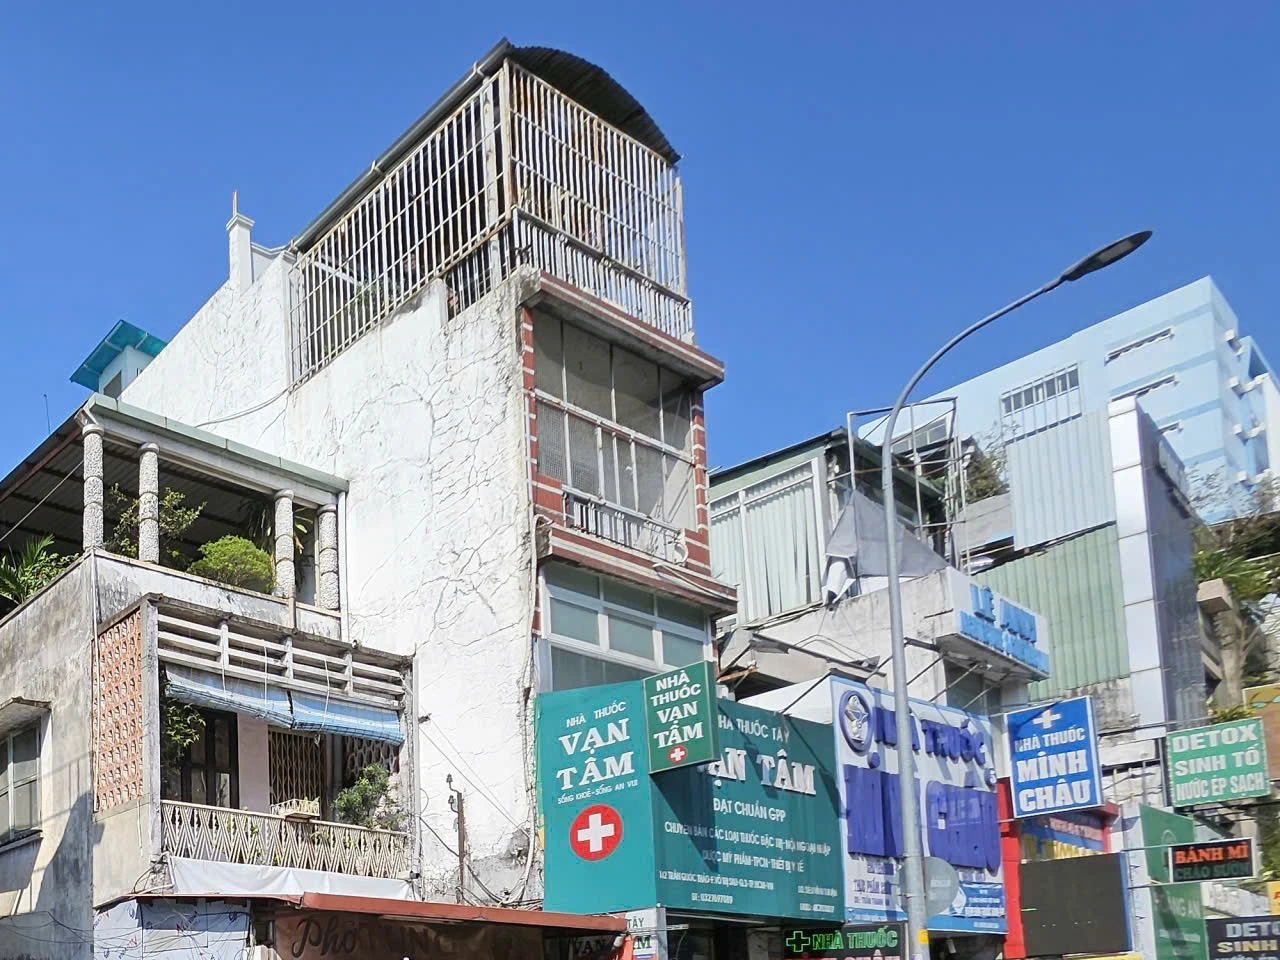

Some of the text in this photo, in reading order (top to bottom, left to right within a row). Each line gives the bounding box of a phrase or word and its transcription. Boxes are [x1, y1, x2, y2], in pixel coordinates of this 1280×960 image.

[655, 670, 690, 692] NHÀ
[650, 683, 702, 707] THUỐC
[566, 699, 627, 728] NHÀ THUỐC
[656, 700, 699, 724] VẠN
[558, 717, 631, 756] VẠN
[653, 722, 704, 749] TÂM
[735, 718, 769, 739] THUỐC
[1042, 724, 1086, 747] THUỐC
[1172, 723, 1259, 753] DETOX
[556, 751, 636, 791] TÂM
[697, 747, 817, 796] ẠN TÂM
[1175, 743, 1260, 777] SINH TỐ
[557, 793, 575, 805] SỐNG
[615, 782, 625, 791] AN
[627, 779, 638, 788] VUI
[1018, 778, 1091, 812] CHÂU
[1211, 774, 1227, 797] ÉP
[1230, 771, 1265, 797] SẠCH
[713, 797, 786, 823] ĐẠT CHUẨN GPP
[708, 825, 724, 841] CÁC
[740, 829, 760, 845] THUỐC
[1175, 842, 1249, 864] BÁNH MÌ
[627, 915, 645, 929] TÂY
[291, 917, 358, 958] Phở
[812, 926, 898, 950] NHÀ THUỐC
[1217, 939, 1278, 953] SINH
